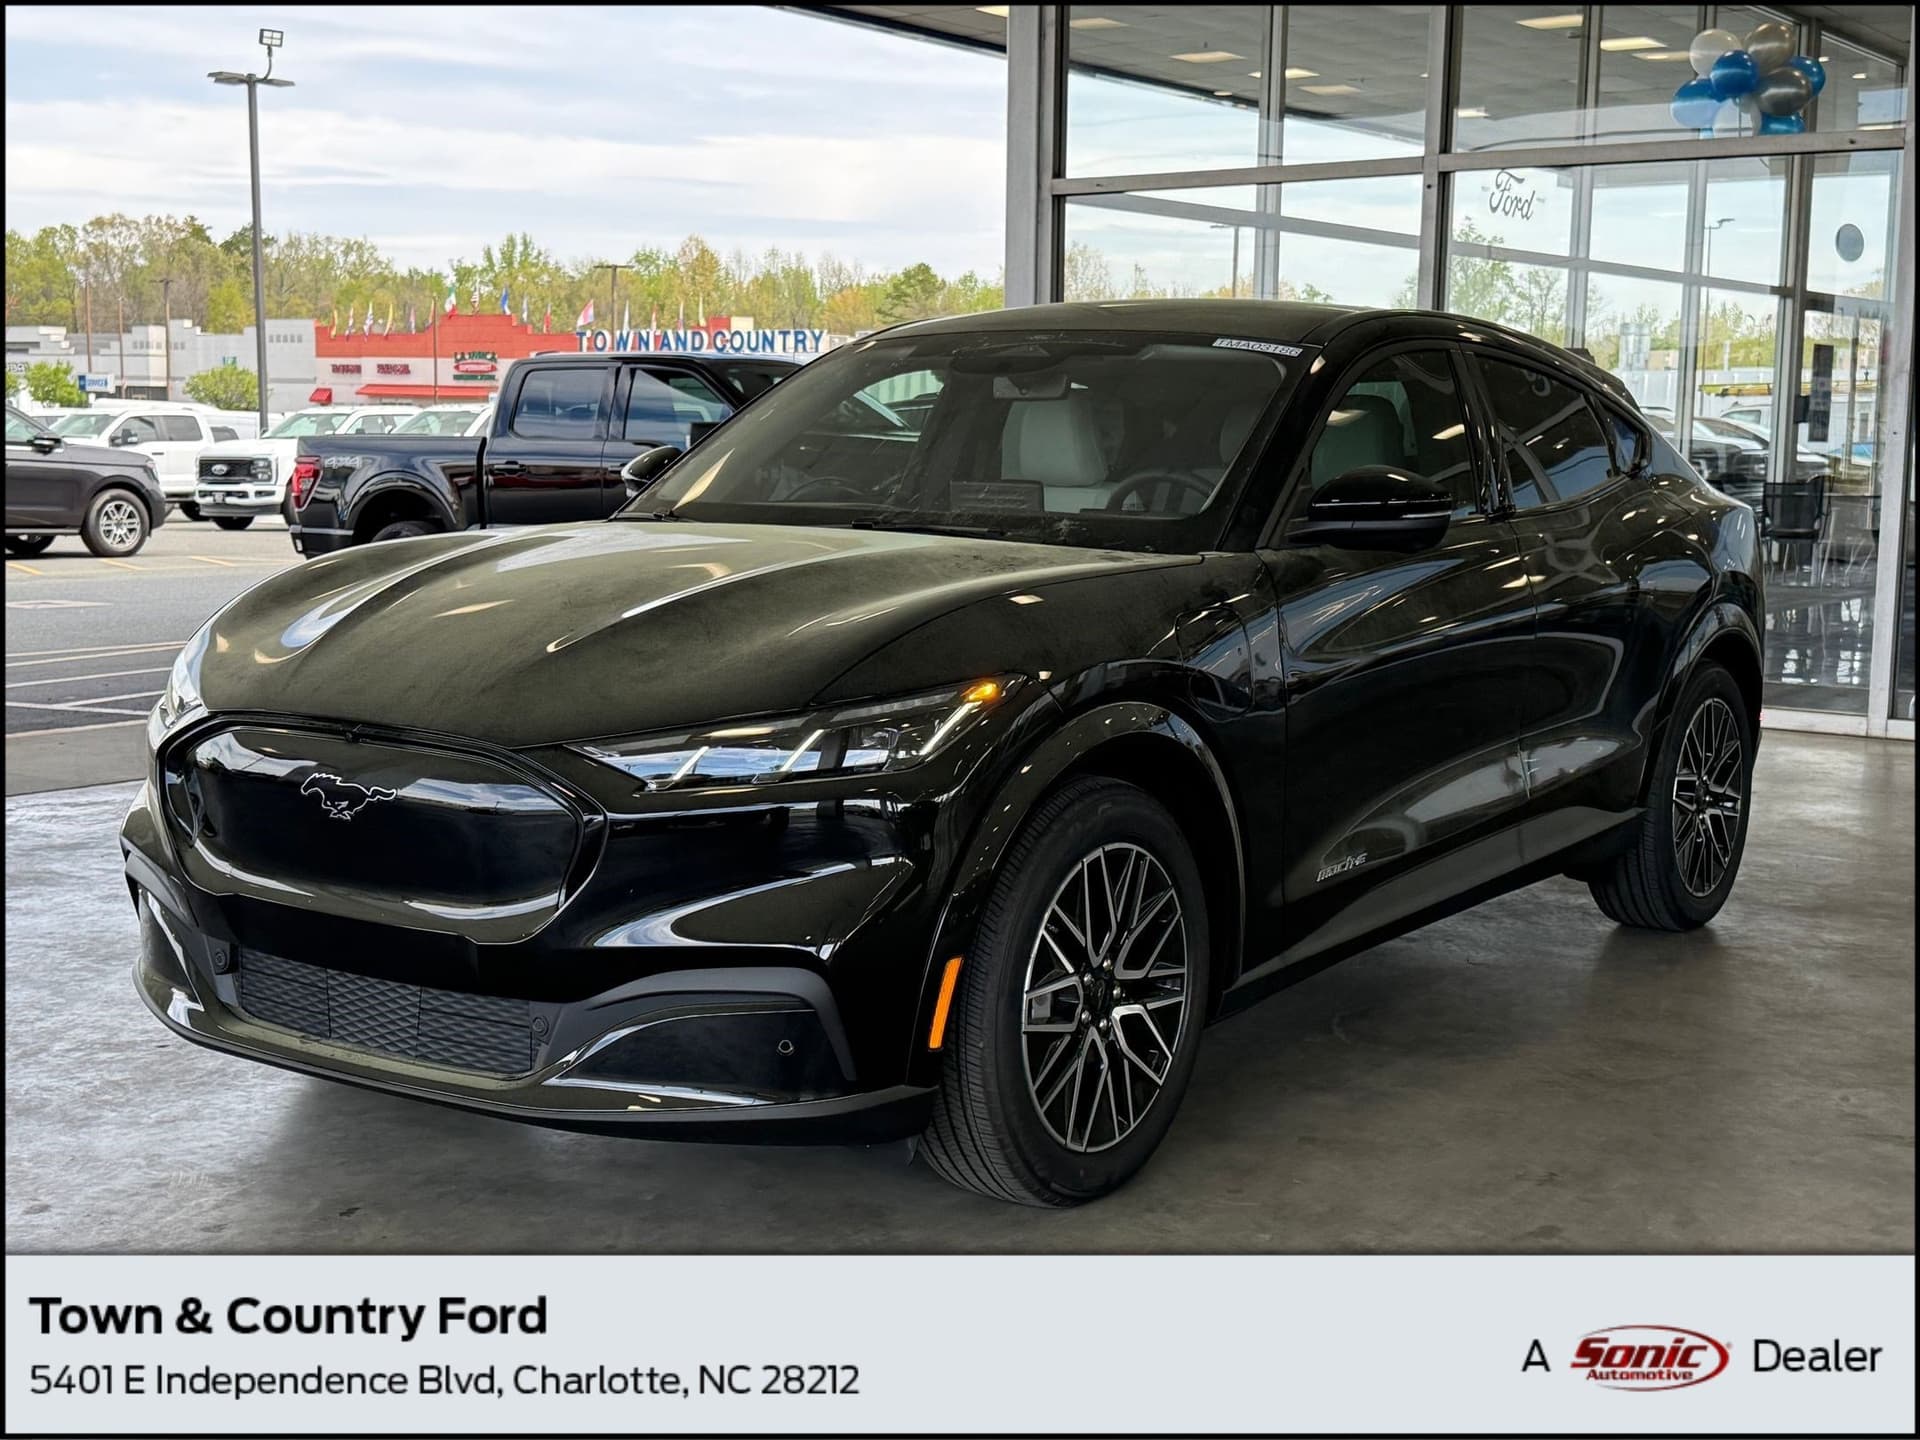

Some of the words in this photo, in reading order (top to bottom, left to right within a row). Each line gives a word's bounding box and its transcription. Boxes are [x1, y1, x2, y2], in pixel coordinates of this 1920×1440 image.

[1489, 169, 1536, 221] Ford
[576, 330, 651, 351] TOWN
[660, 330, 705, 351] AND
[712, 330, 826, 352] COUNTRY
